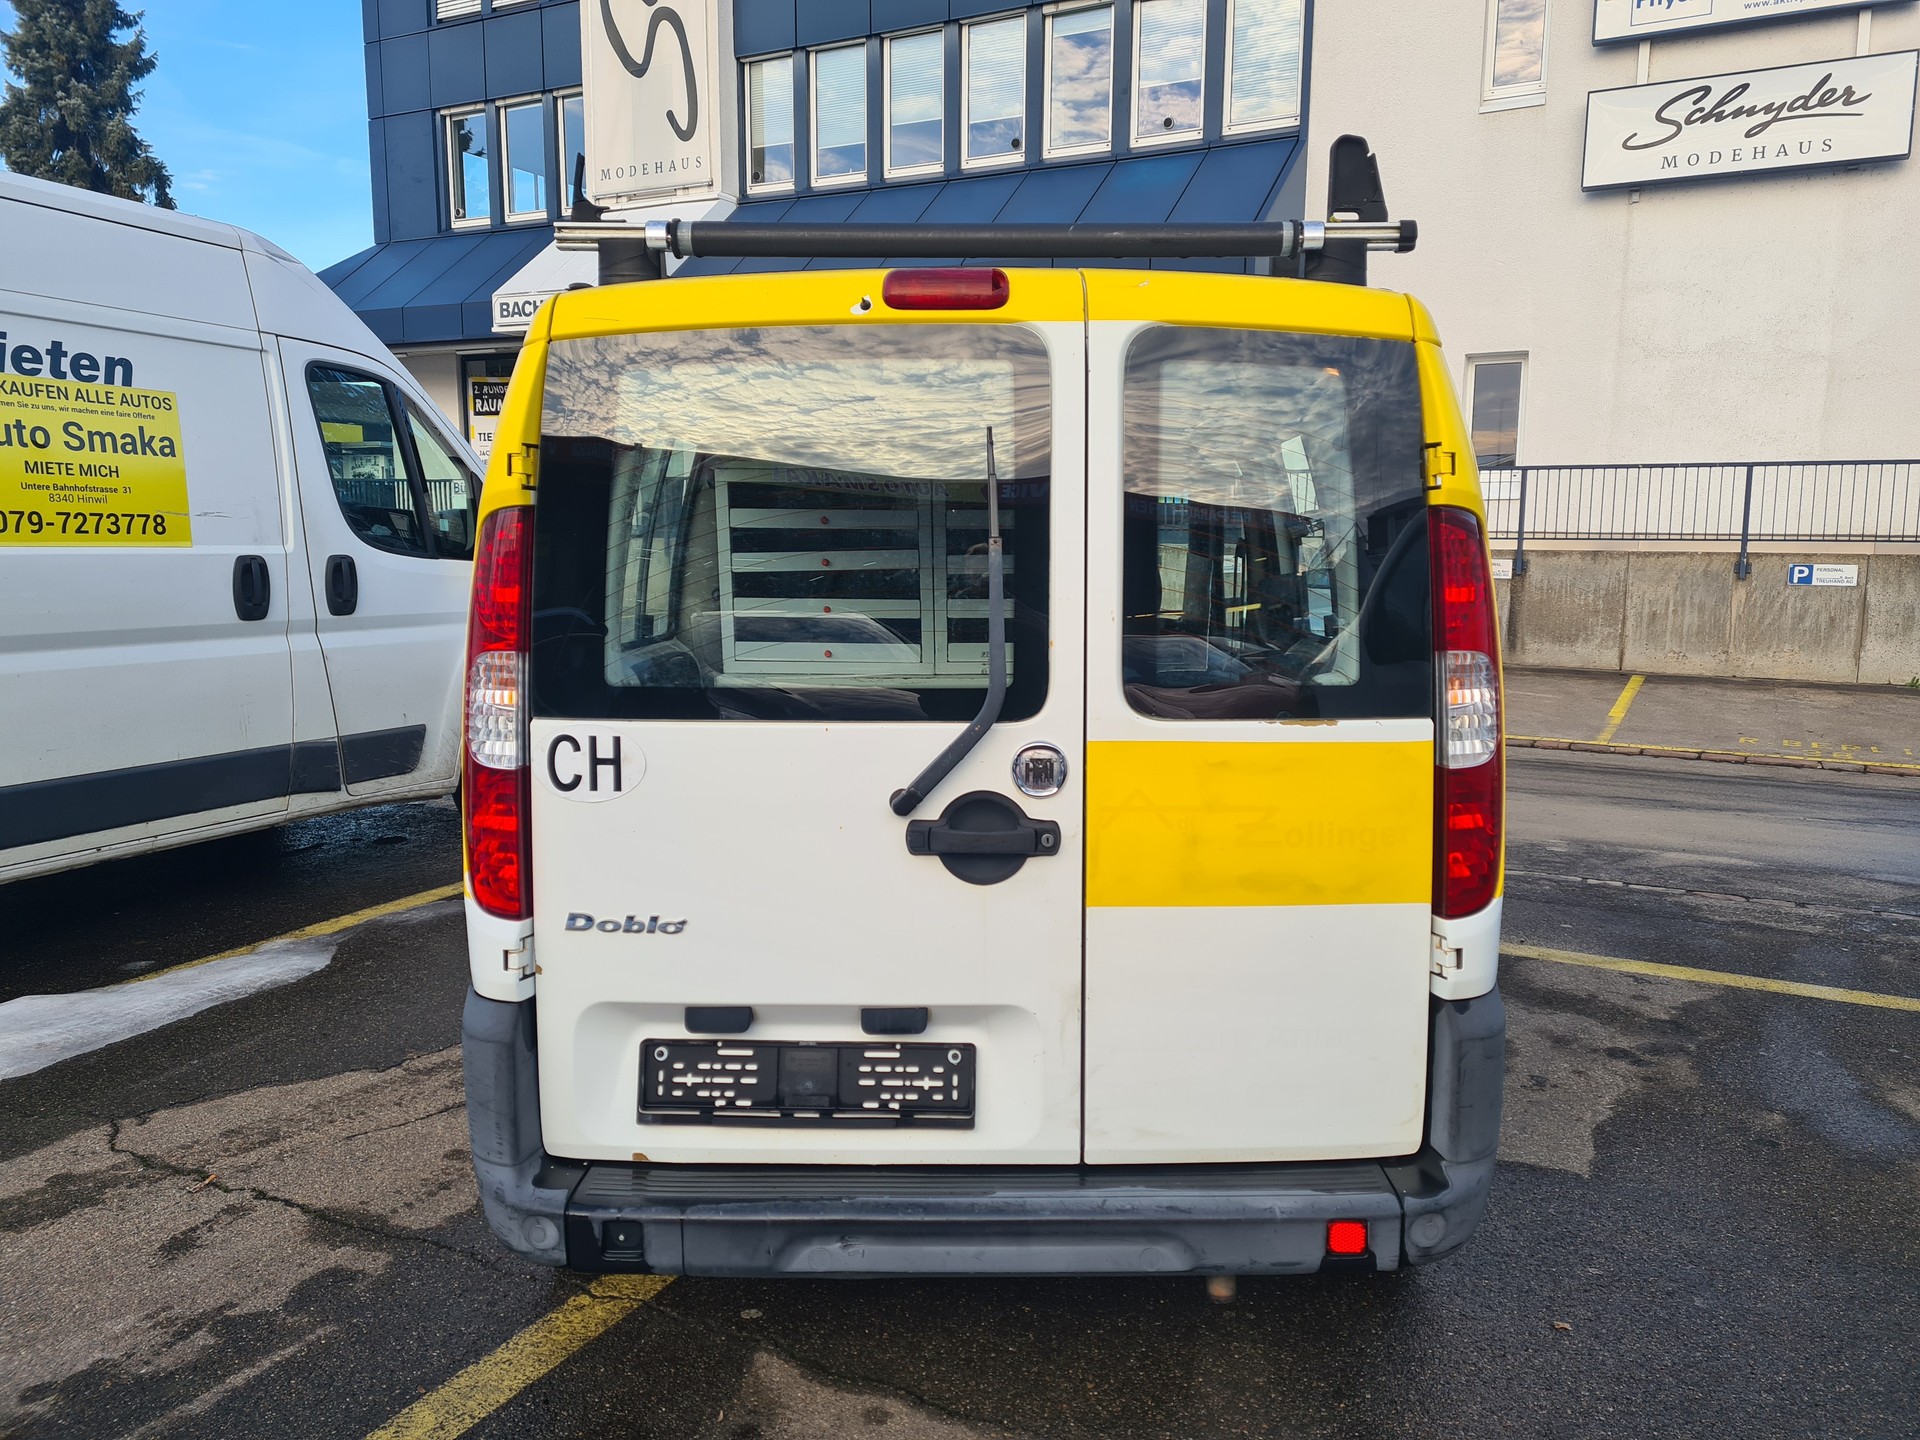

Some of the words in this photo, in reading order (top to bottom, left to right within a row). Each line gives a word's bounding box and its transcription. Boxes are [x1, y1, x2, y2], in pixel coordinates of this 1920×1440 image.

[1622, 73, 1873, 150] Schnyder
[1661, 139, 1833, 169] MODEHAUS
[600, 155, 703, 181] MODEHAUS
[17, 401, 29, 409] Sie
[71, 407, 99, 416] machen
[116, 411, 131, 419] faire
[132, 412, 156, 420] Offerte
[74, 388, 115, 406] ALLE
[120, 392, 172, 411] AUTOS
[62, 421, 177, 458] Smaka
[24, 460, 75, 476] MIETE
[79, 463, 120, 478] MICH
[20, 482, 50, 491] Untere
[52, 483, 119, 494] Bahnhofstrasse
[122, 486, 132, 494] 31
[48, 493, 75, 503] 8340
[77, 495, 108, 504] Hinwil
[1793, 566, 1809, 583] P
[547, 734, 622, 792] CH
